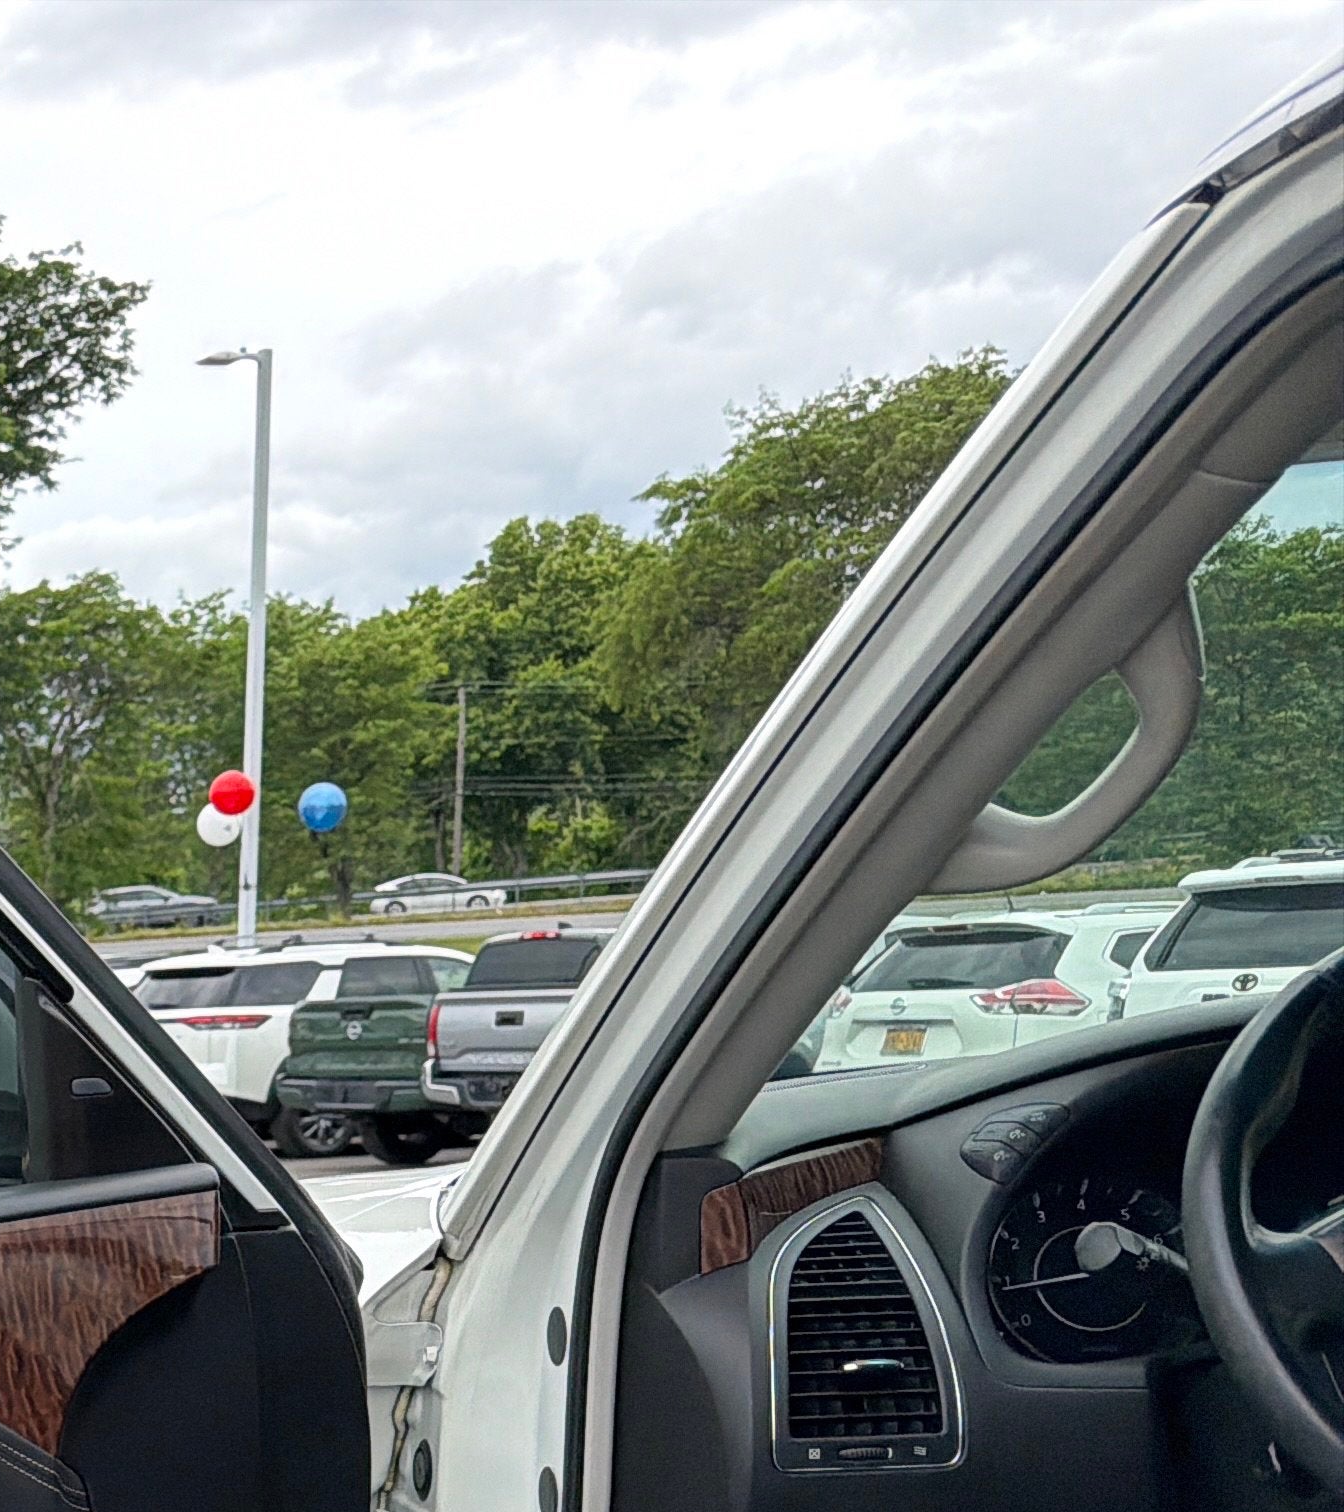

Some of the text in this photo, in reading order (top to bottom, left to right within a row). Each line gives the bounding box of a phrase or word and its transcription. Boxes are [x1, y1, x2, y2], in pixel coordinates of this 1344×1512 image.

[1077, 1199, 1086, 1210] 4
[1036, 1210, 1046, 1224] 3
[1120, 1207, 1131, 1221] 5
[1011, 1237, 1020, 1250] 2
[1020, 1313, 1032, 1327] 0
